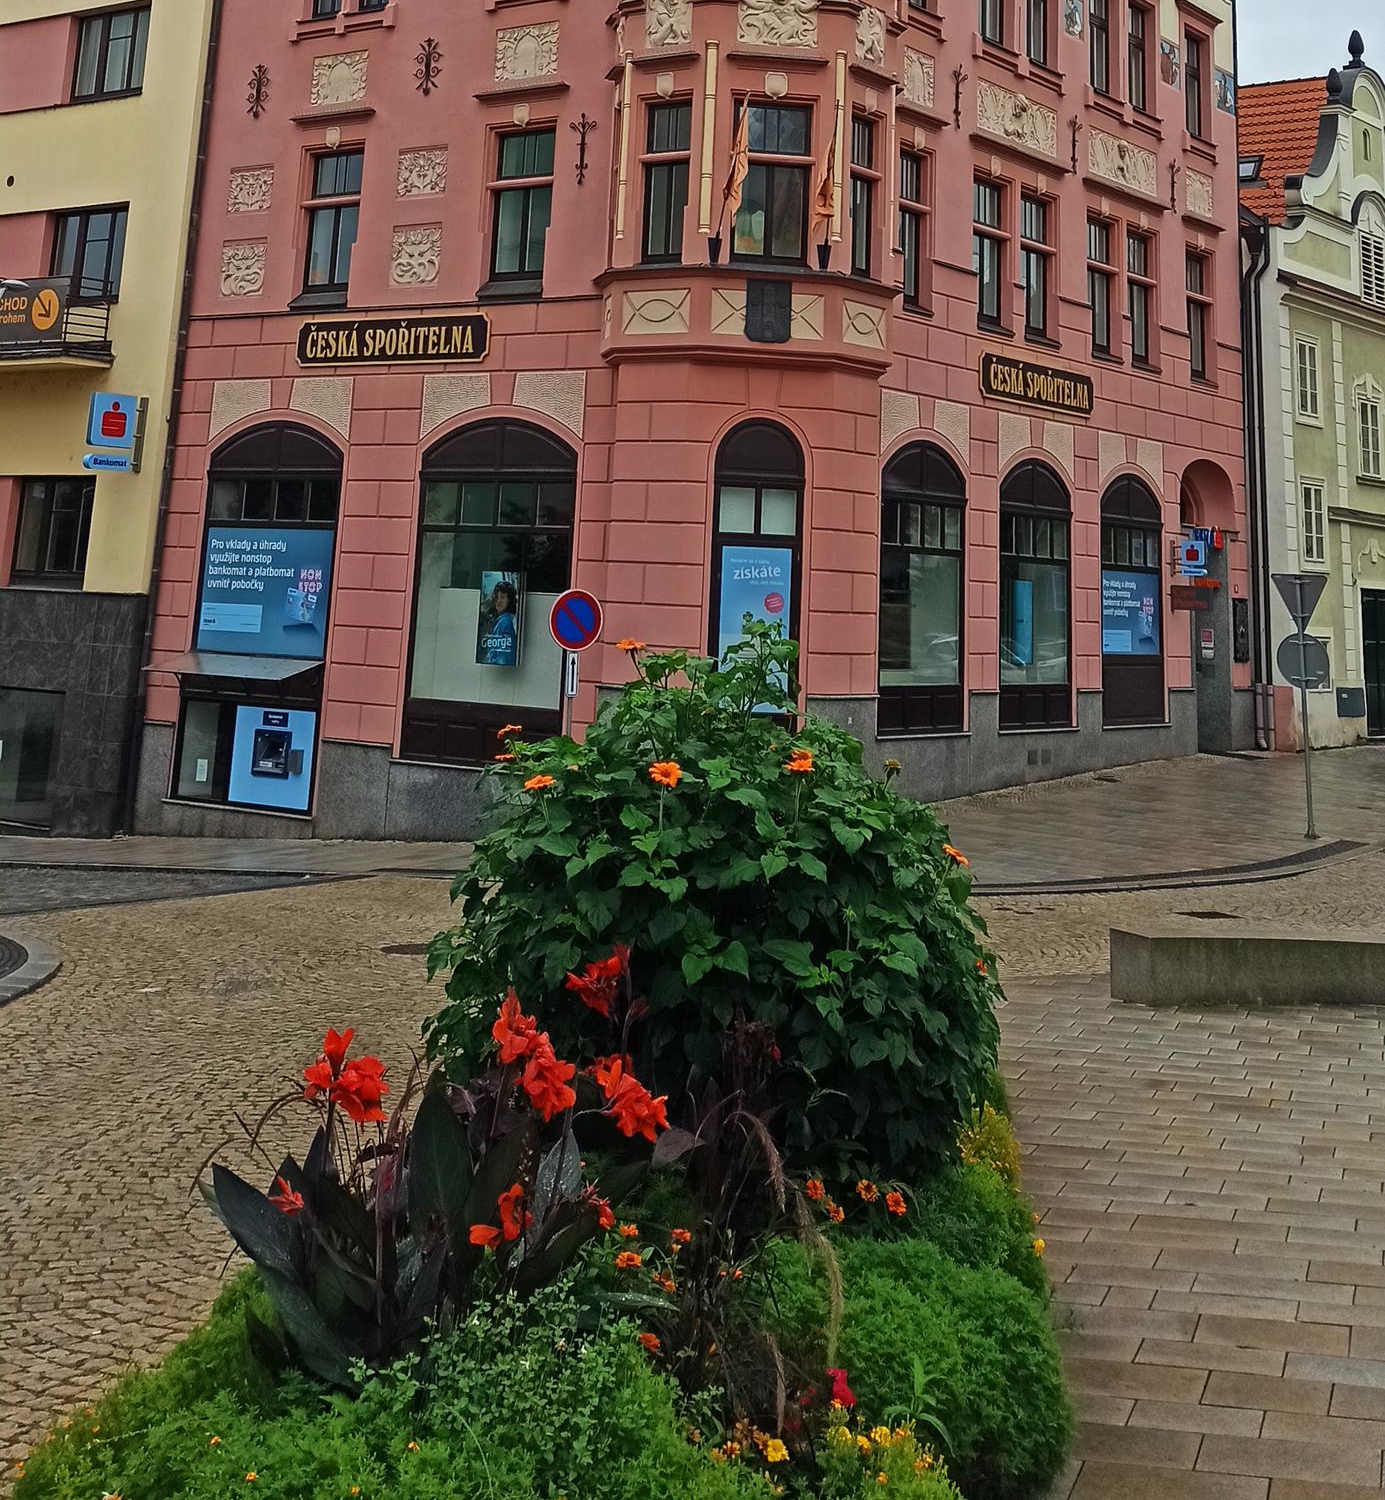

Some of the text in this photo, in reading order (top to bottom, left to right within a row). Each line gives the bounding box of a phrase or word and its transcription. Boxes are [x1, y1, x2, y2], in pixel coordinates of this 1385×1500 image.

[306, 320, 474, 359] ČESKÁ SPOŘITELNA
[990, 357, 1089, 410] ČESKÁ SPOŘITELNA
[93, 457, 127, 467] Bankomat
[211, 539, 287, 553] Pro vklady a úhrady
[210, 552, 272, 565] využijte nonstop
[208, 565, 295, 578] bankomat a platbomat
[733, 565, 781, 580] získáte
[207, 578, 264, 592] uvnitř pobočky
